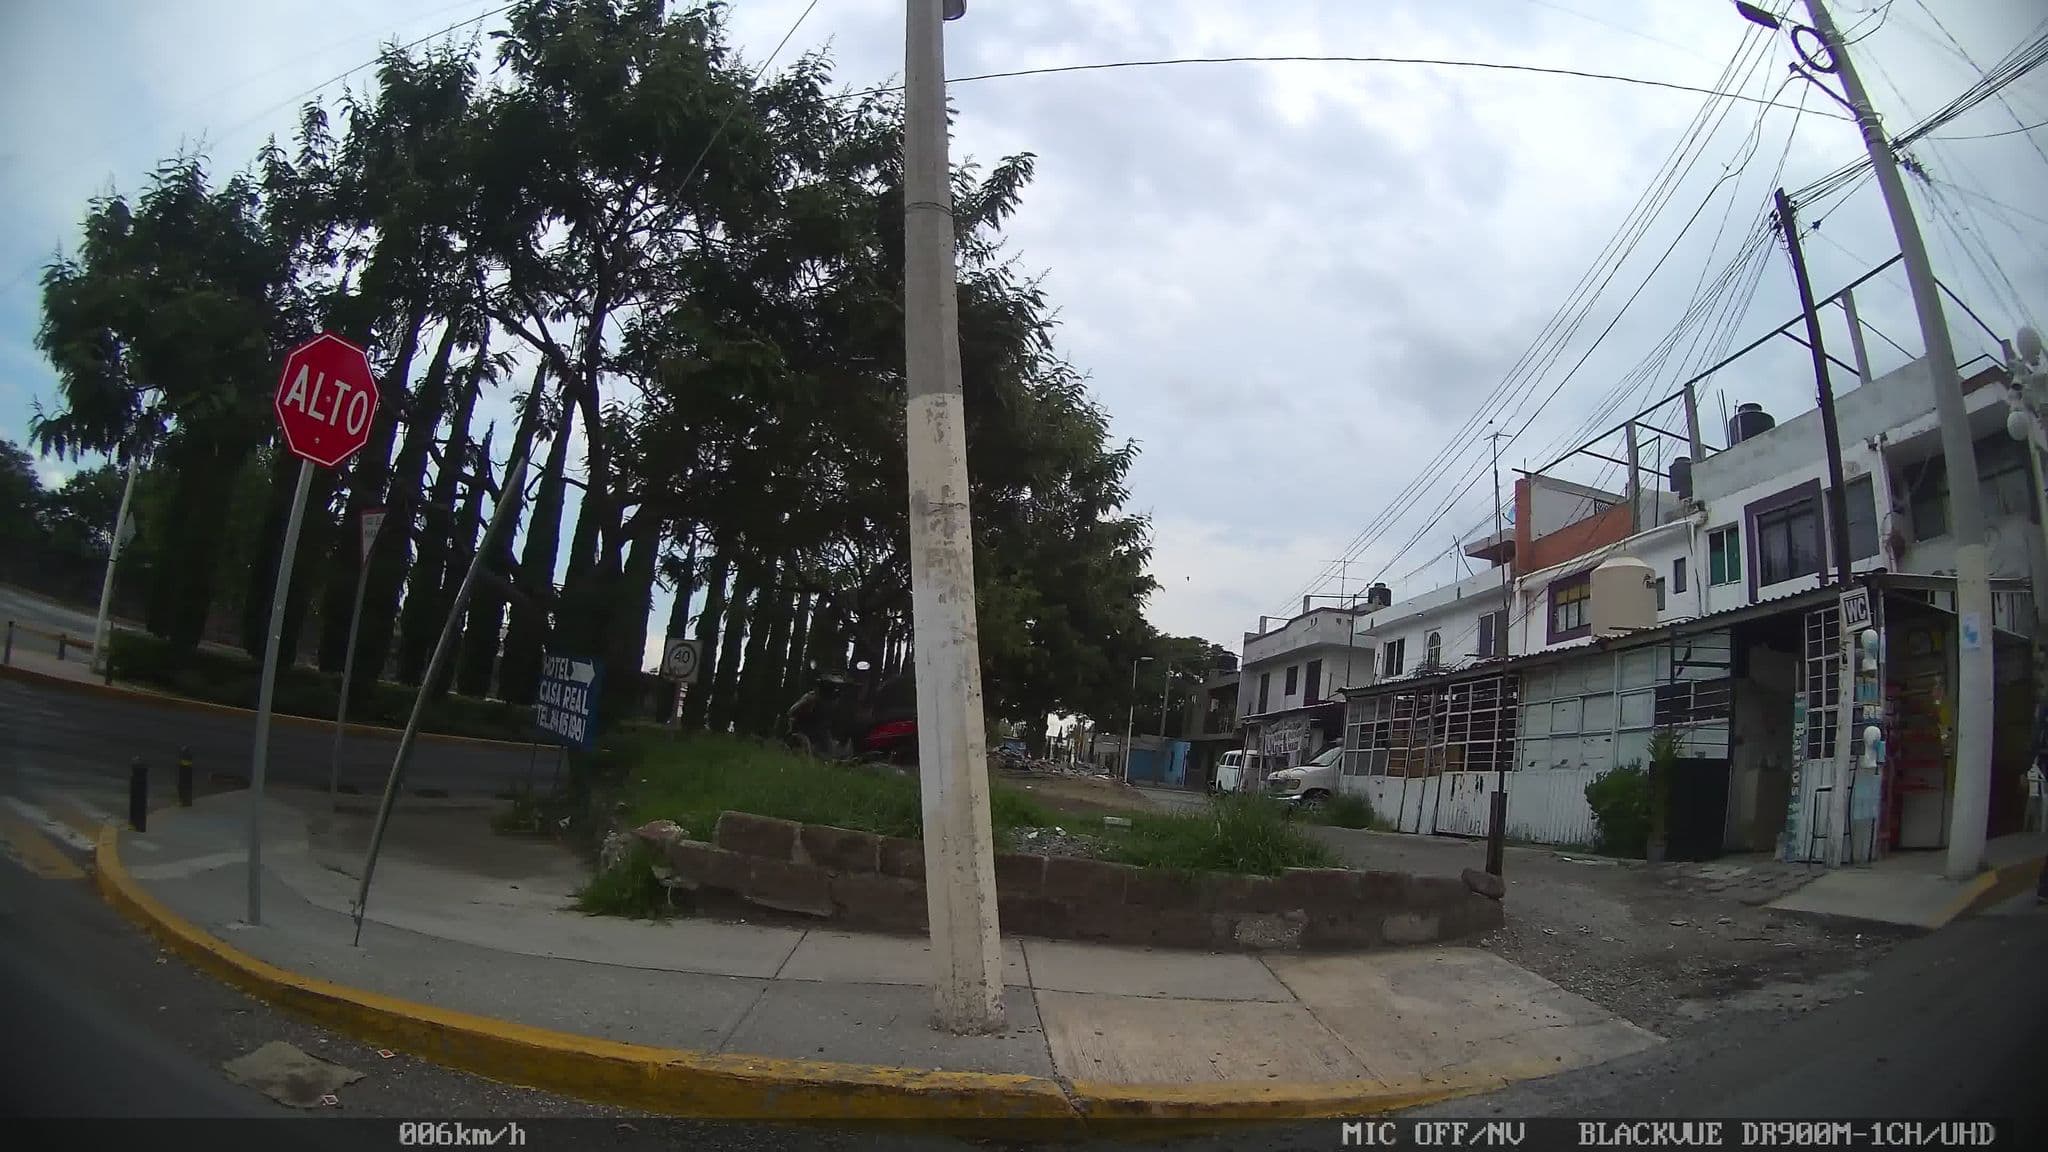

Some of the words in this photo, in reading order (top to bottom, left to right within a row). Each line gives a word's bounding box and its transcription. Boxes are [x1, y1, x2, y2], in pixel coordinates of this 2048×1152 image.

[283, 364, 368, 435] ALTO
[1846, 598, 1867, 623] WC
[543, 656, 570, 681] HOTEL
[674, 649, 690, 663] 40
[539, 680, 561, 707] CASA
[562, 686, 589, 716] REAL
